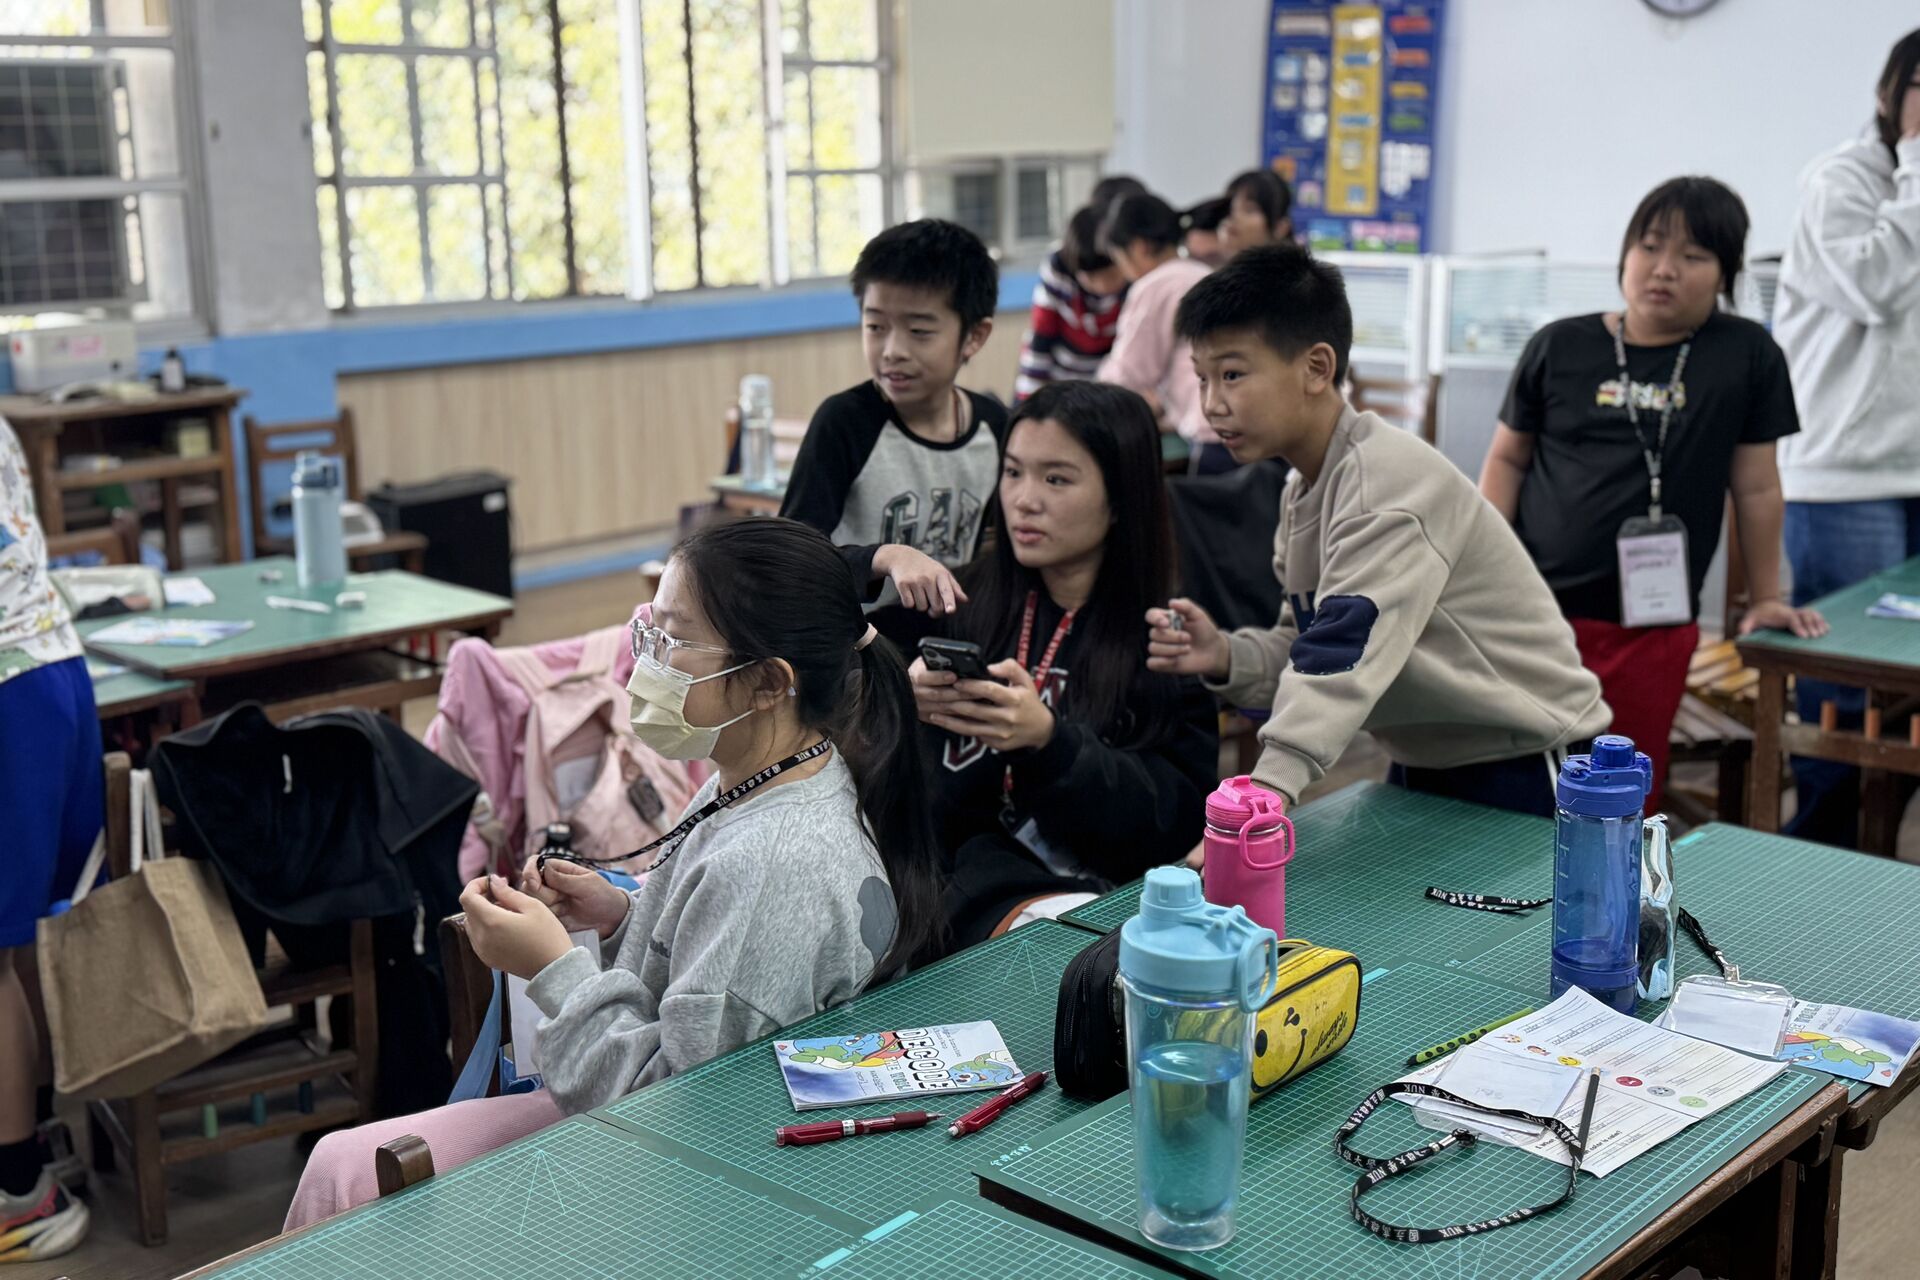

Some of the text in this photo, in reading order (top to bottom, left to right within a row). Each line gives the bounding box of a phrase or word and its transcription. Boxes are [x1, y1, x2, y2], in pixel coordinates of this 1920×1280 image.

[893, 1028, 957, 1090] DECODE
[1403, 1083, 1425, 1094] NUK
[1366, 1166, 1387, 1184] NUK
[1438, 1225, 1464, 1238] NUK
